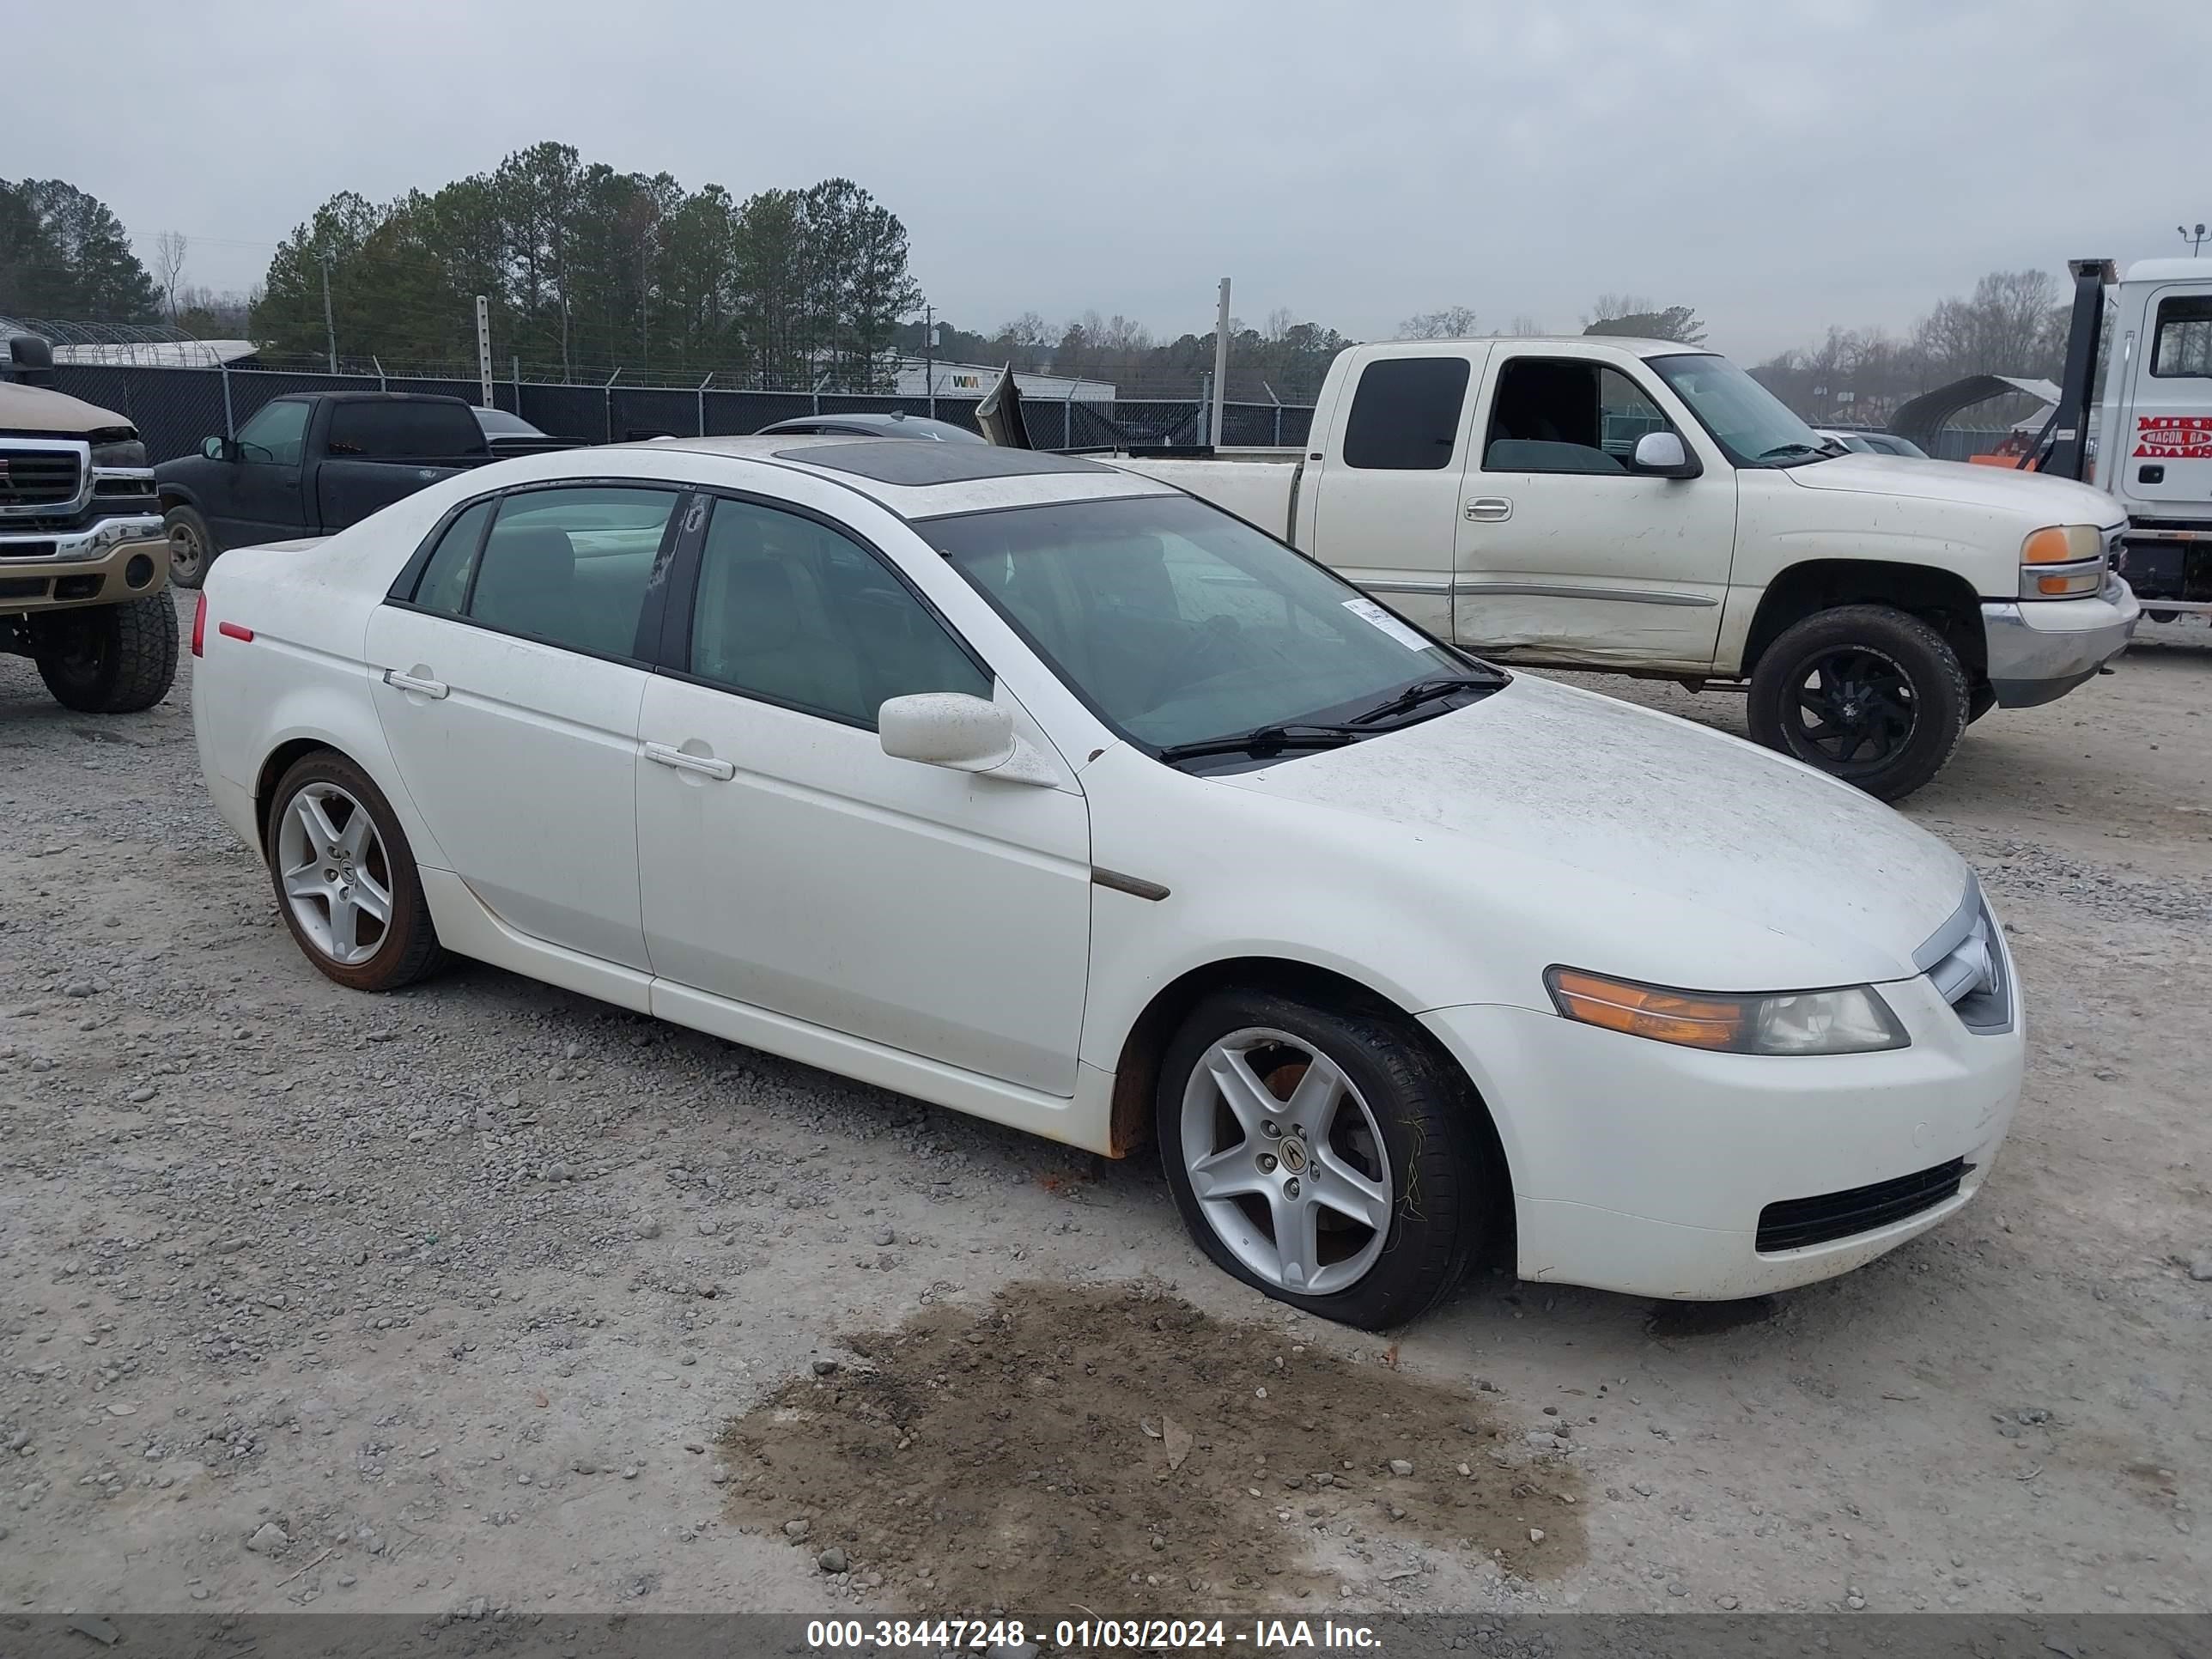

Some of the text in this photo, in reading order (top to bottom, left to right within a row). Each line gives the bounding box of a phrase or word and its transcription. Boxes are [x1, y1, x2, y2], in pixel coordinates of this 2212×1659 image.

[952, 374, 979, 389] WM
[2136, 416, 2212, 431] MIKE
[2147, 431, 2185, 446] MACON,
[2131, 444, 2212, 459] ADAMS
